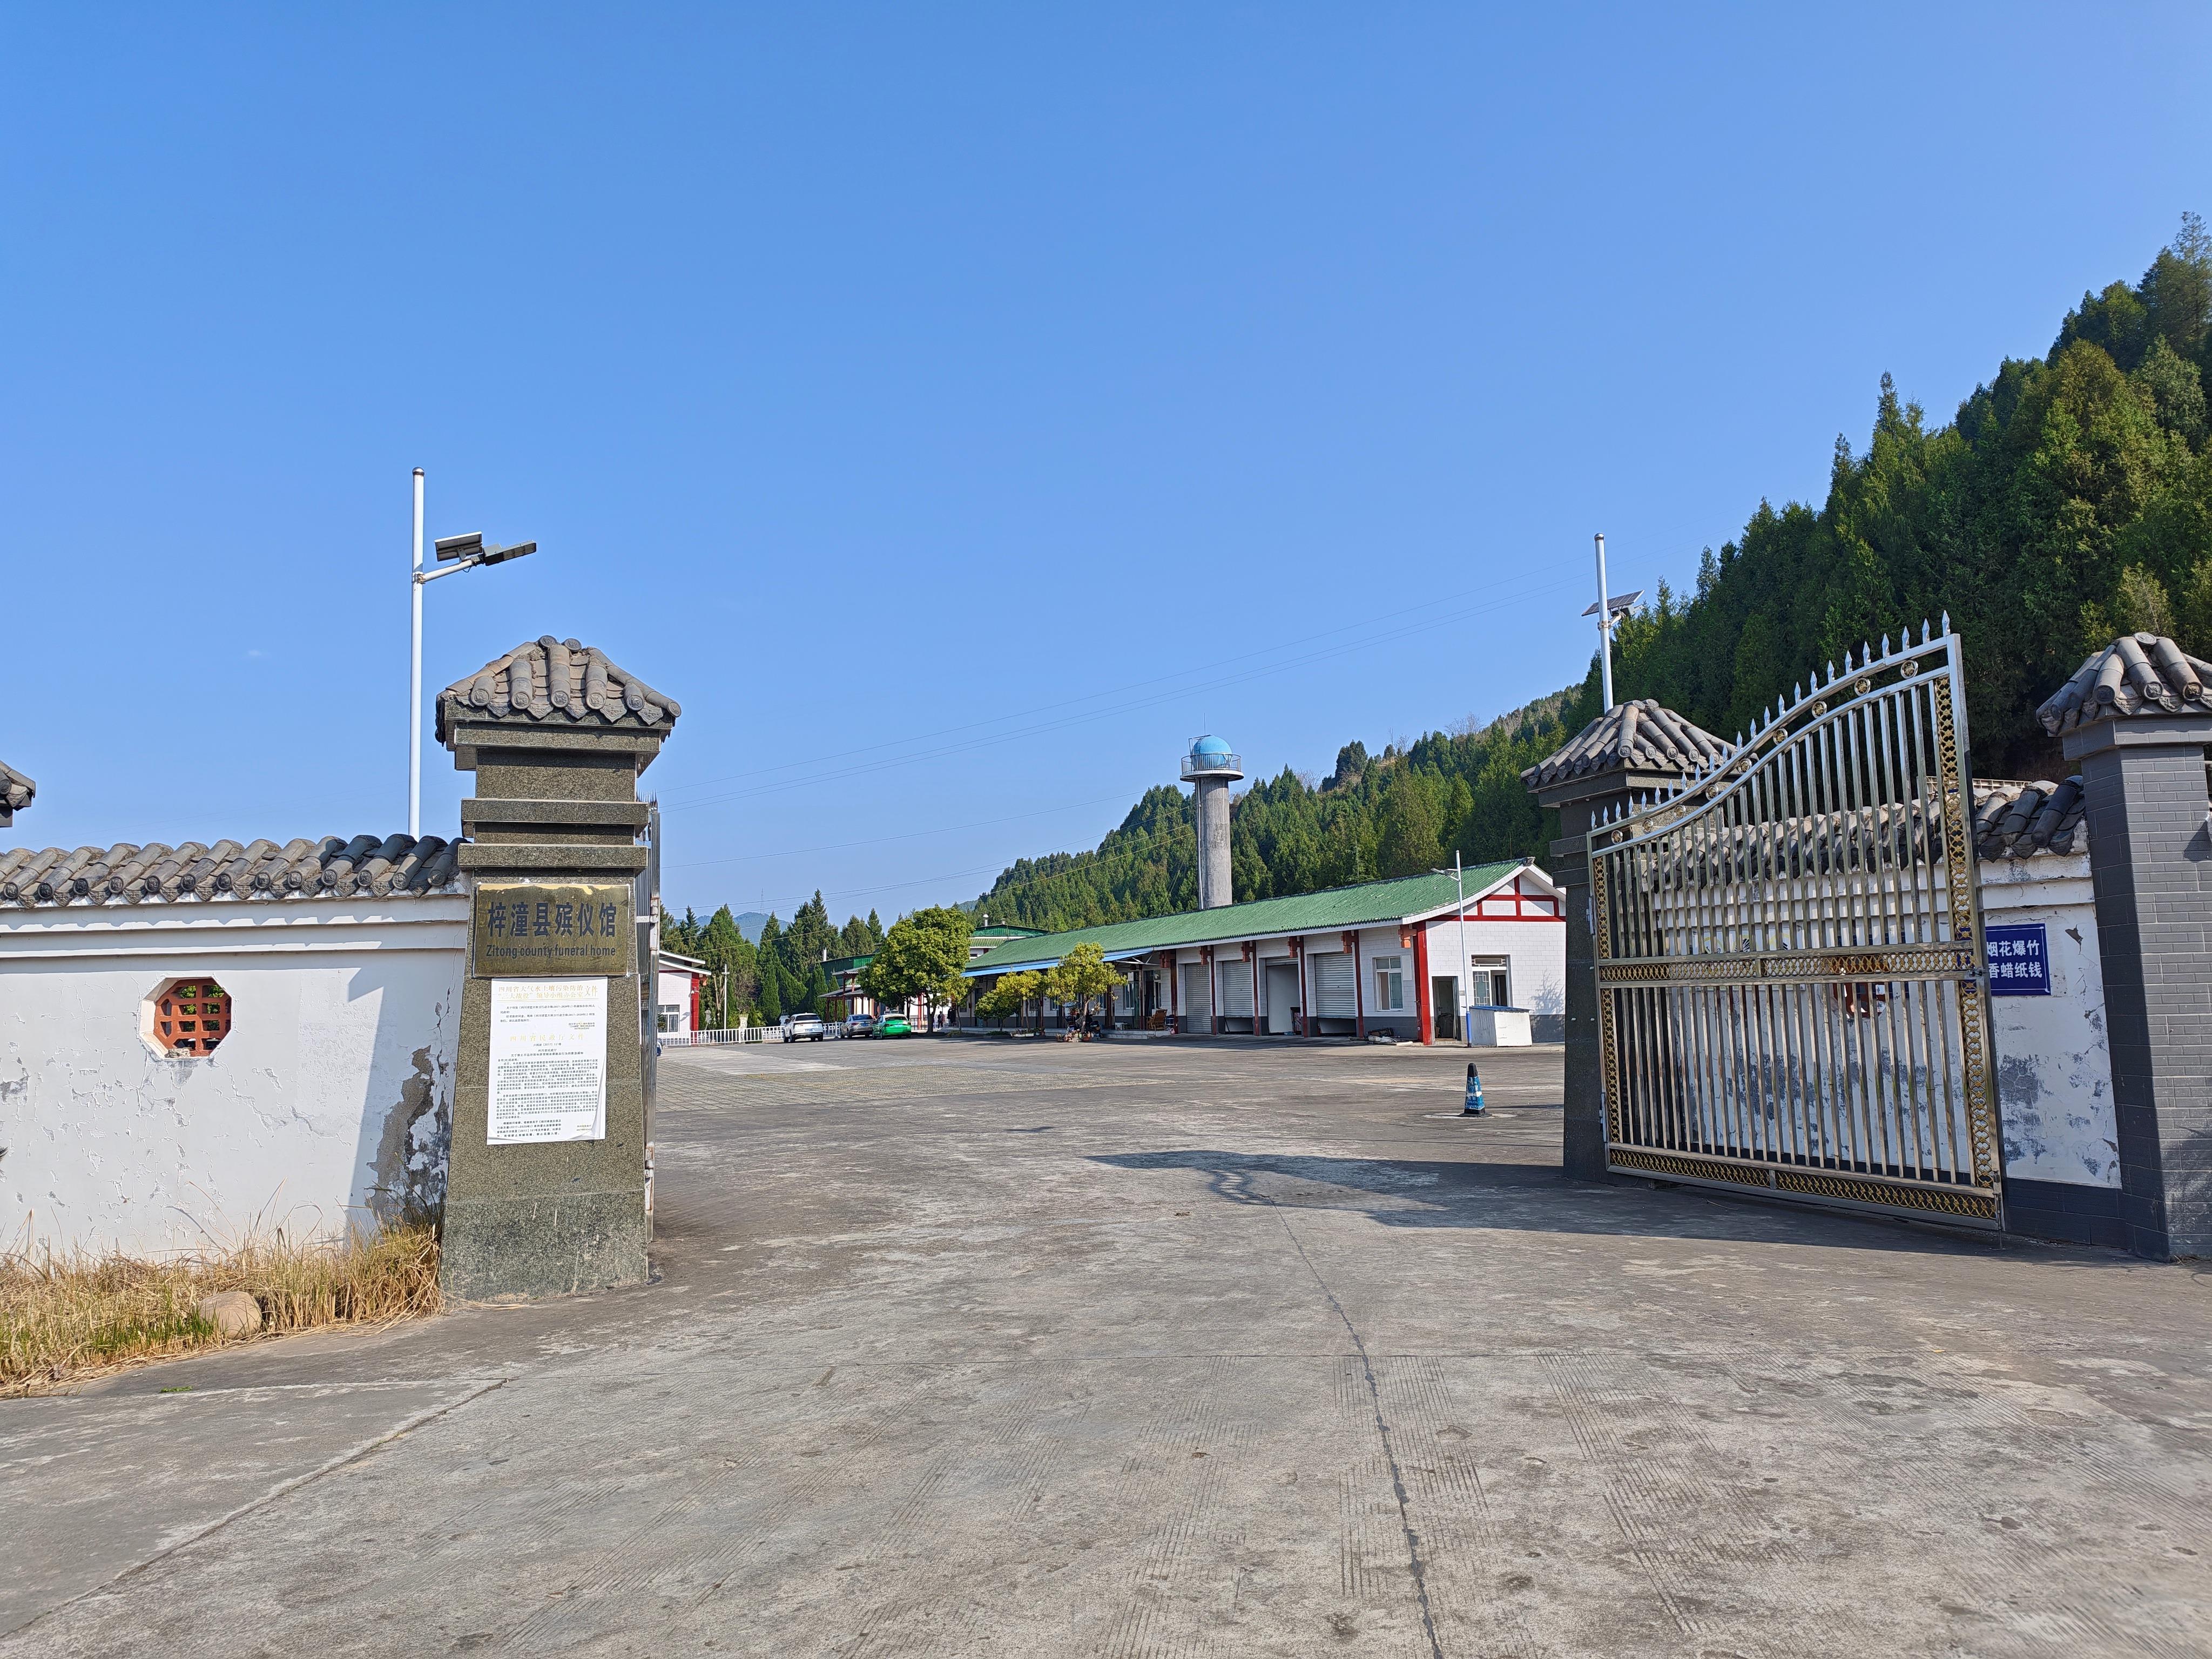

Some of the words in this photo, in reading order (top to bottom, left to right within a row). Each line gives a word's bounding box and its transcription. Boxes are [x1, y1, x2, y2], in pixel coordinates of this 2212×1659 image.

[488, 902, 617, 938] 梓潼县殡仪馆
[487, 945, 517, 959] Zitong
[520, 947, 552, 959] county
[555, 945, 588, 956] funeral
[591, 945, 616, 956] home
[1986, 940, 2040, 957] 烟花爆竹
[1988, 961, 2042, 979] 香蜡纸钱
